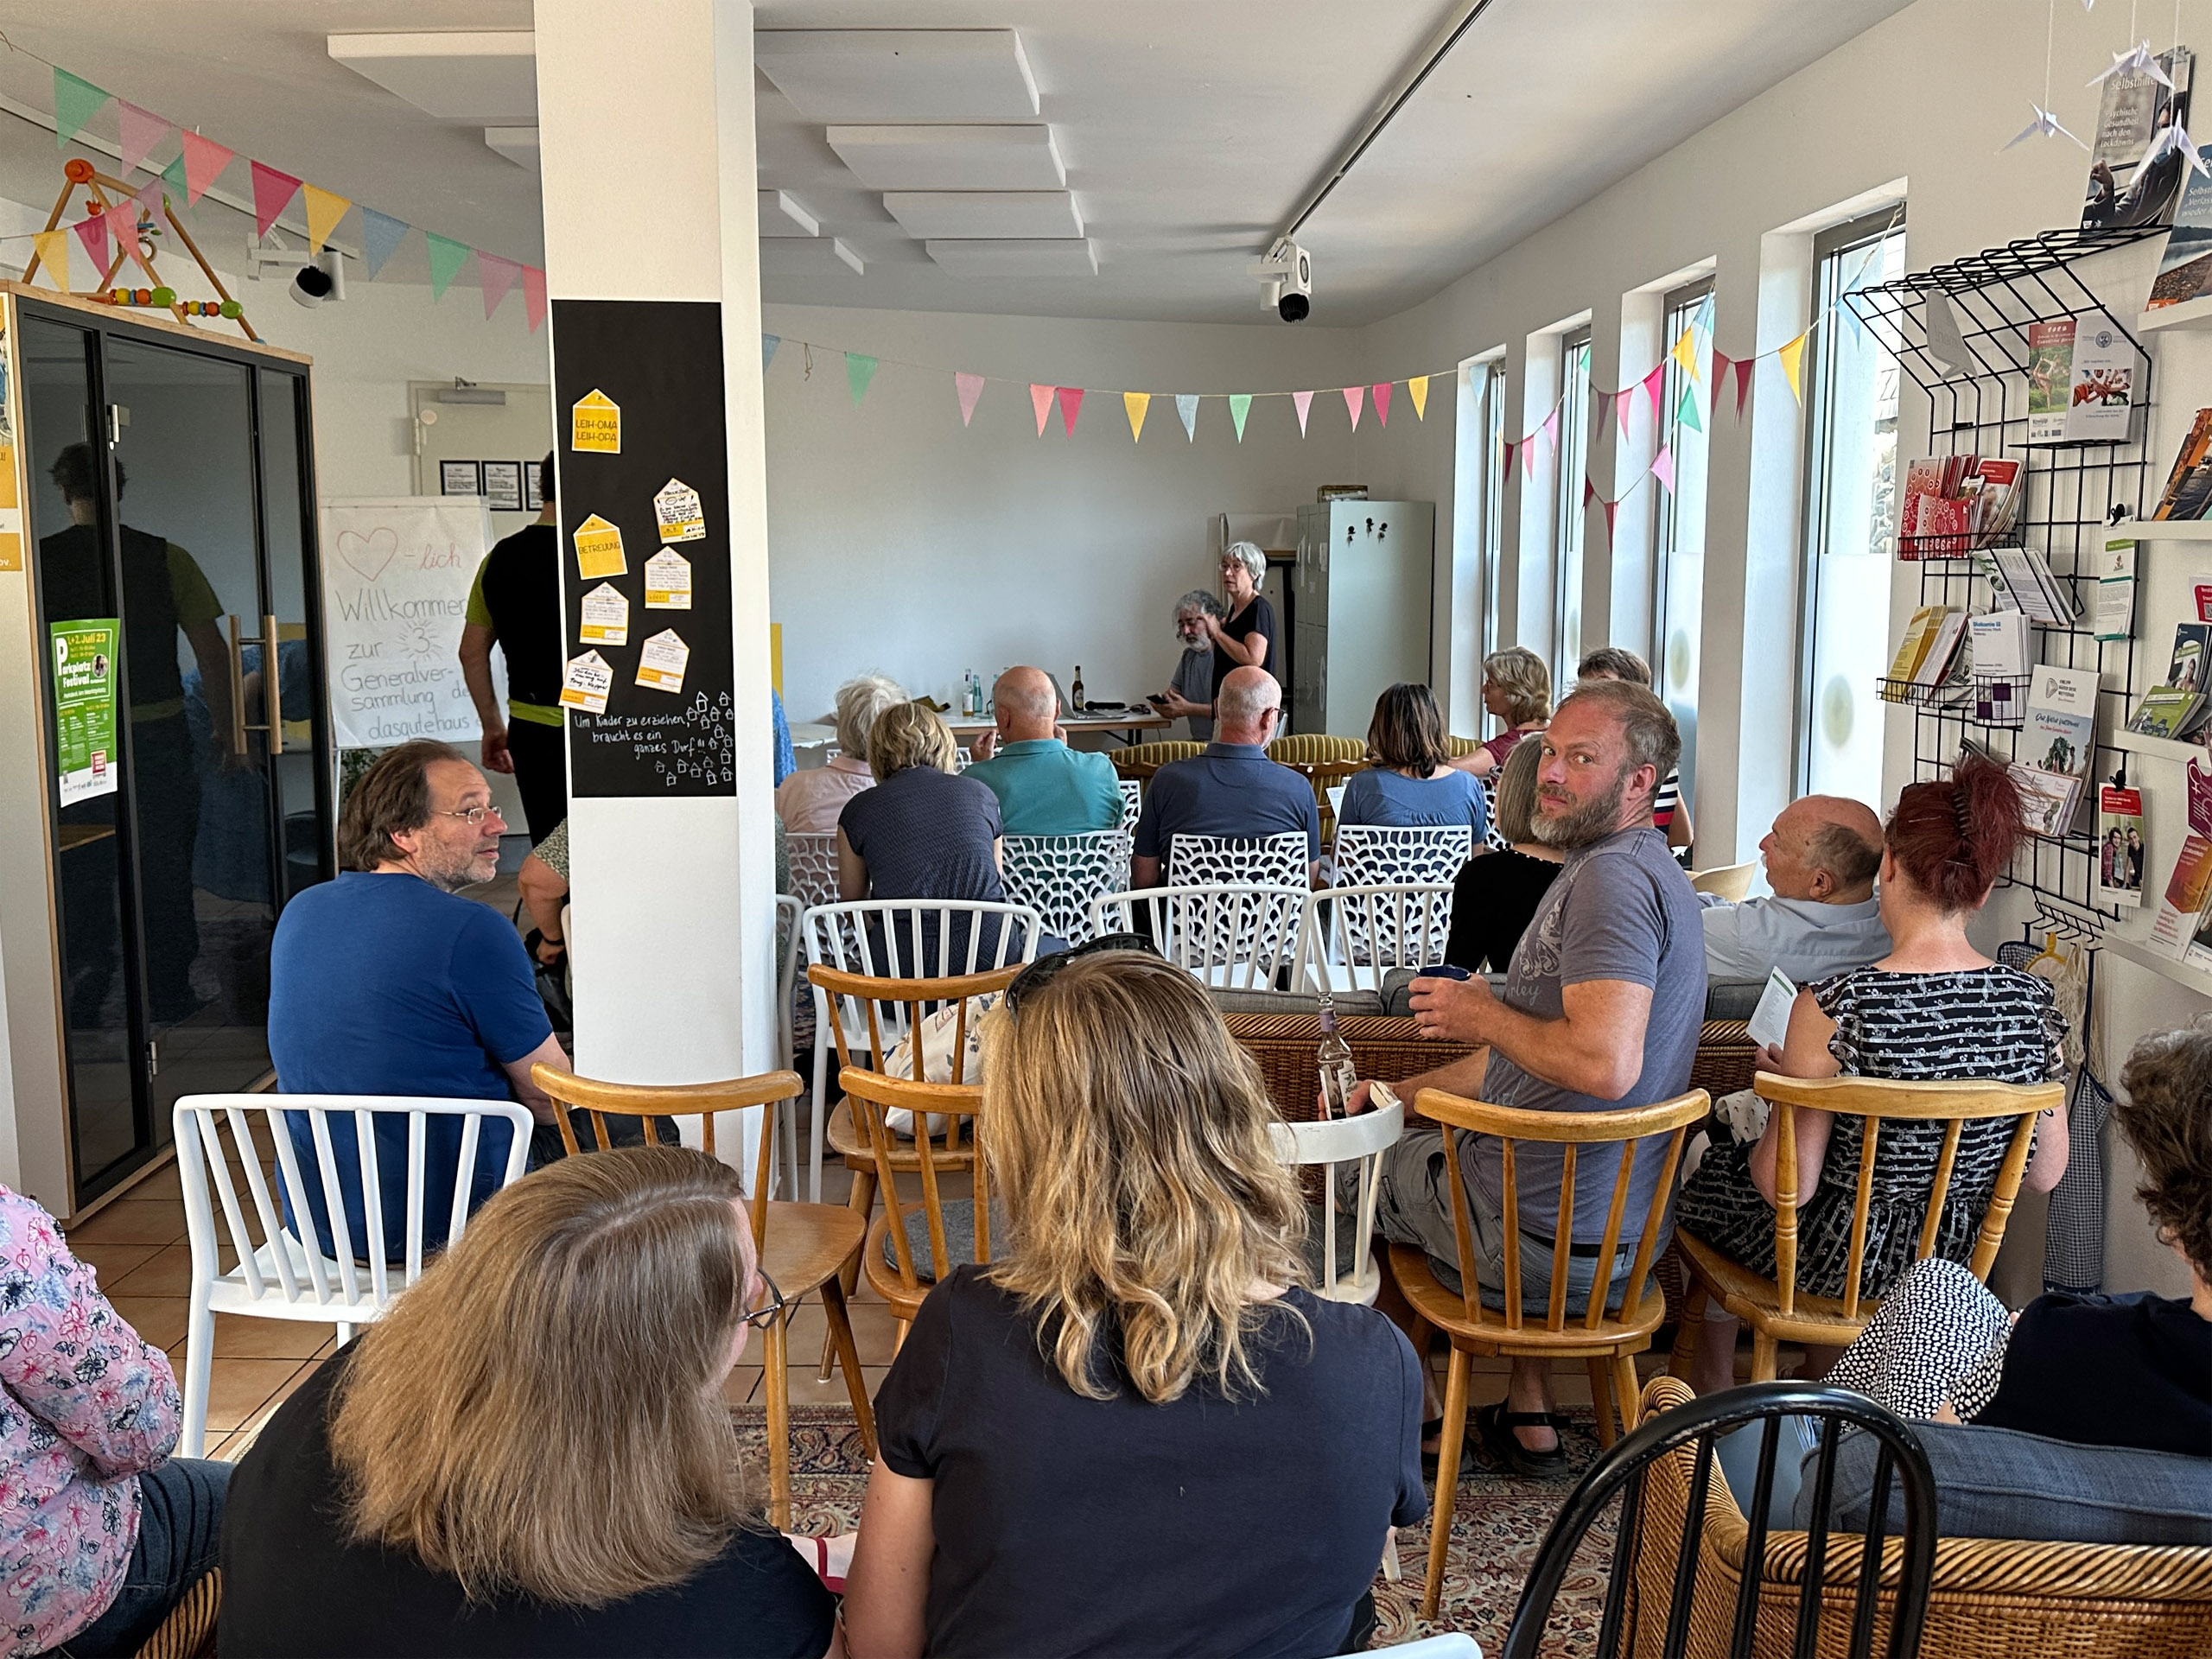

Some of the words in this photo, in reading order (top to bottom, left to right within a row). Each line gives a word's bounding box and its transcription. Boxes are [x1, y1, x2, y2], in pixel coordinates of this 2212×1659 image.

[2103, 118, 2139, 128] Gesundheit
[2101, 129, 2117, 137] nach
[2119, 128, 2131, 137] den
[2100, 138, 2134, 148] Lockdowns
[575, 419, 618, 429] LEIH-OMA
[576, 432, 617, 442] LEIH-OPA
[578, 542, 620, 555] BETREUUNG
[80, 632, 95, 644] Juli
[96, 632, 106, 643] 23
[346, 641, 383, 659] zur
[55, 638, 91, 677] Parkplatz
[63, 673, 90, 688] Festival
[340, 661, 454, 692] Generalver-
[351, 690, 435, 715] sammlung
[452, 680, 470, 699] de
[575, 715, 590, 728] Um
[595, 714, 622, 728] Kinder
[626, 716, 638, 727] zu
[640, 715, 690, 728] erziehen,
[592, 730, 631, 743] braucht
[633, 732, 643, 741] es
[646, 731, 662, 741] ein
[633, 741, 666, 760] ganzes
[1507, 974, 1541, 1006] rley
